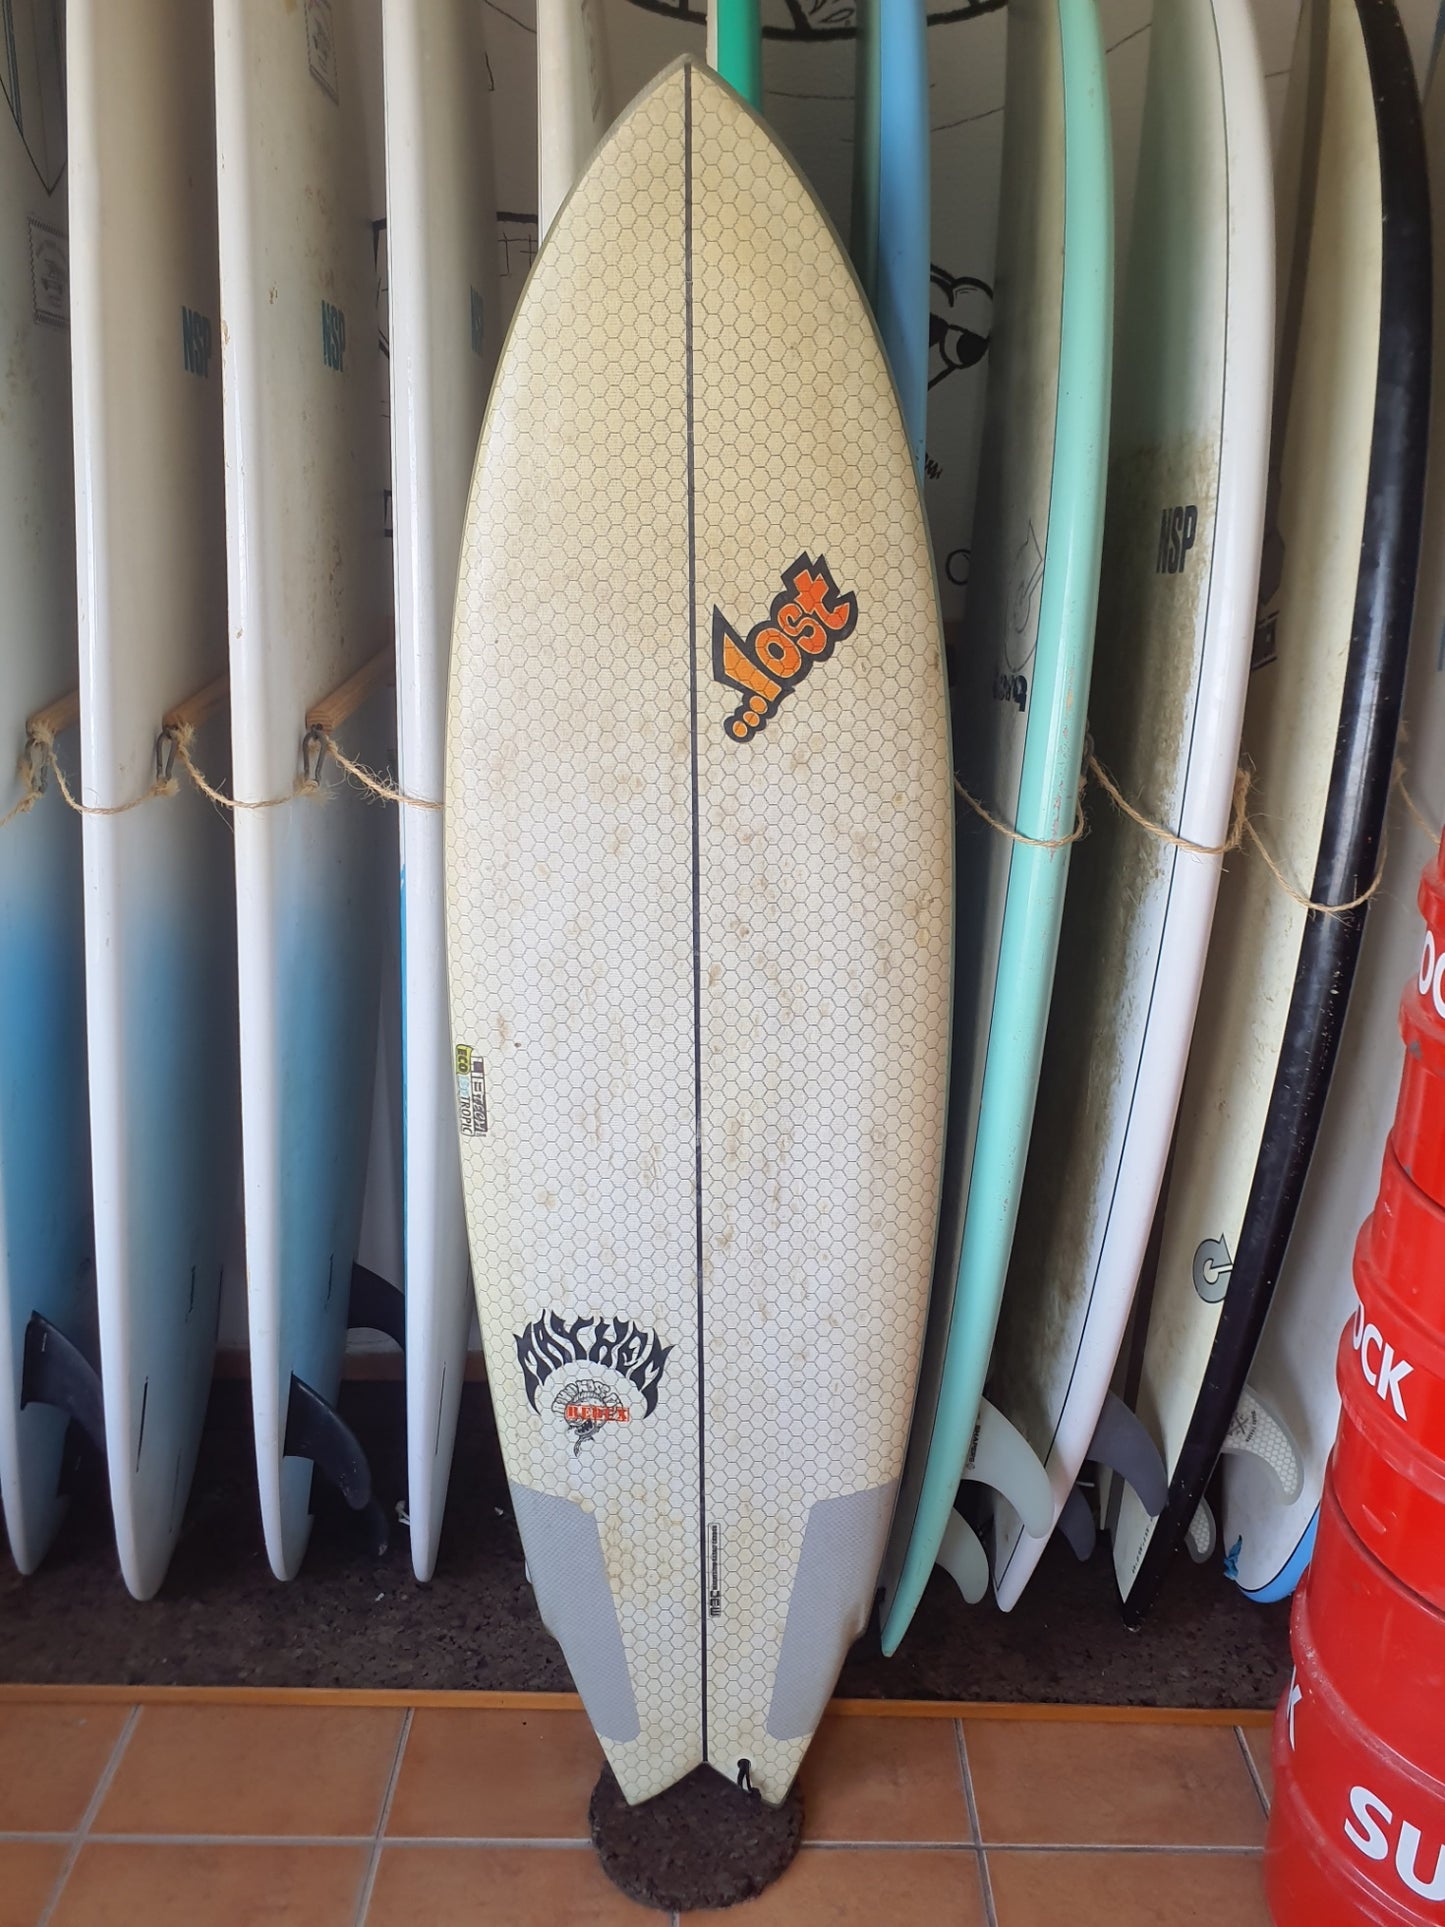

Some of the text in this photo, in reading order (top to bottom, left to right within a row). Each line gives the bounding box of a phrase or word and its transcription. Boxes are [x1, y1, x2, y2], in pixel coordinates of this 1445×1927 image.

[321, 299, 346, 373] NSP
[1156, 505, 1197, 574] NSP
[458, 1048, 469, 1073] ECO
[461, 1096, 473, 1134] TROPIC
